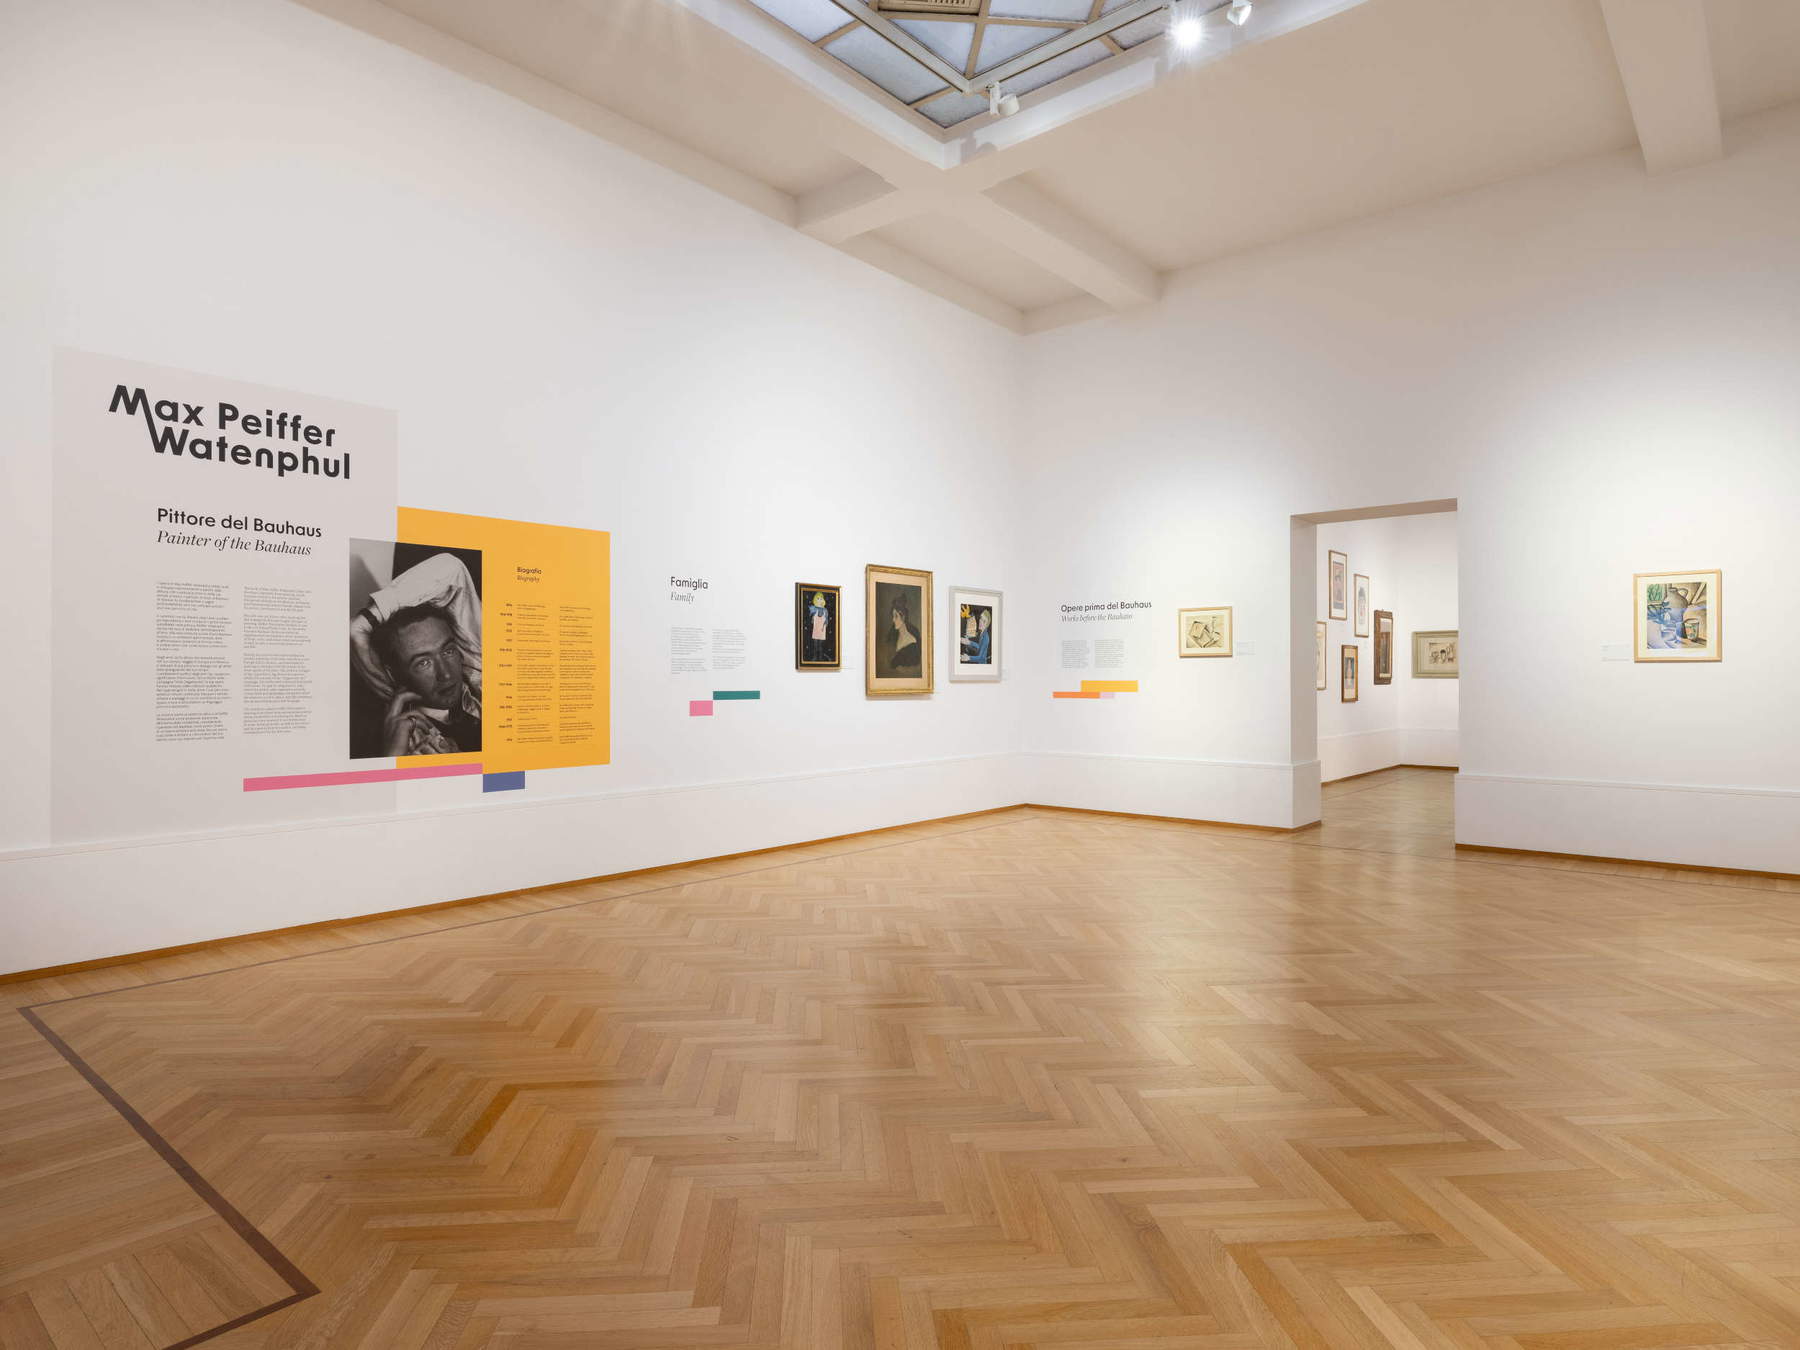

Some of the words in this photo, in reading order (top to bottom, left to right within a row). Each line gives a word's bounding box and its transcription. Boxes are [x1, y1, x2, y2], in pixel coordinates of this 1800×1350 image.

[109, 384, 204, 427] Max
[218, 402, 336, 448] Peiffer
[152, 425, 351, 480] Watenphul
[157, 507, 216, 527] Pittore
[220, 511, 248, 531] del
[253, 517, 322, 538] Bauhaus
[157, 530, 213, 548] Painter
[213, 535, 231, 552] of
[230, 536, 252, 551] the
[254, 539, 312, 556] Bauhaus
[516, 566, 542, 575] Biografia
[670, 576, 709, 591] Famiglia
[670, 591, 695, 605] Family
[1060, 604, 1083, 613] Opere
[1084, 603, 1105, 613] prima
[1106, 602, 1119, 610] del
[1120, 601, 1152, 609] Bauhaus
